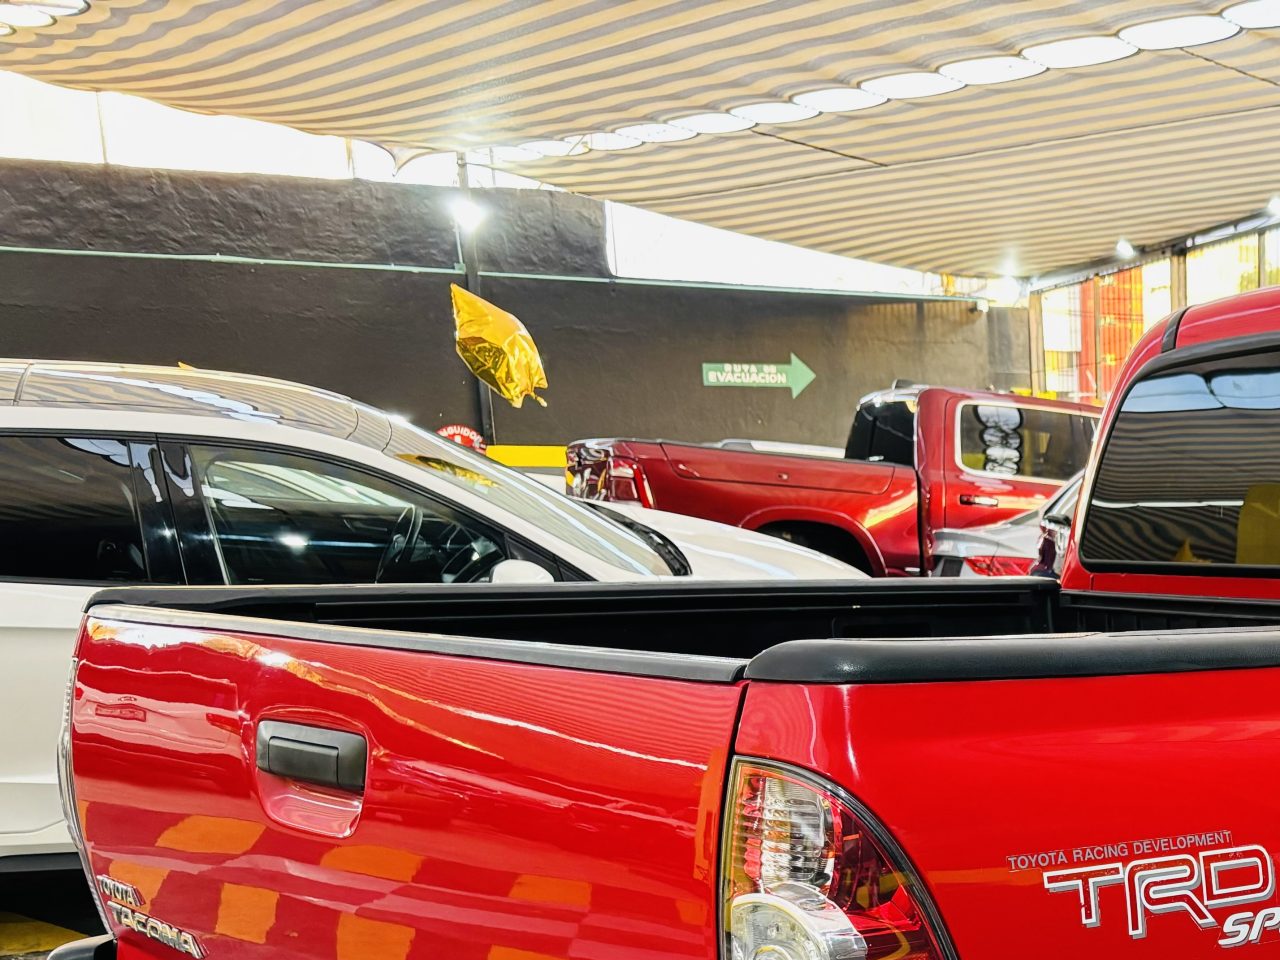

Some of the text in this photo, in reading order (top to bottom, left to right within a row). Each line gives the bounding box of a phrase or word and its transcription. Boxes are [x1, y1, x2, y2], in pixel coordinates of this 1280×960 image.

[1008, 831, 1231, 870] TOYOTA RACING DEVELOPMENT
[97, 874, 142, 907] TOYOTA
[1042, 844, 1275, 939] TRD
[107, 900, 206, 960] TACOMA
